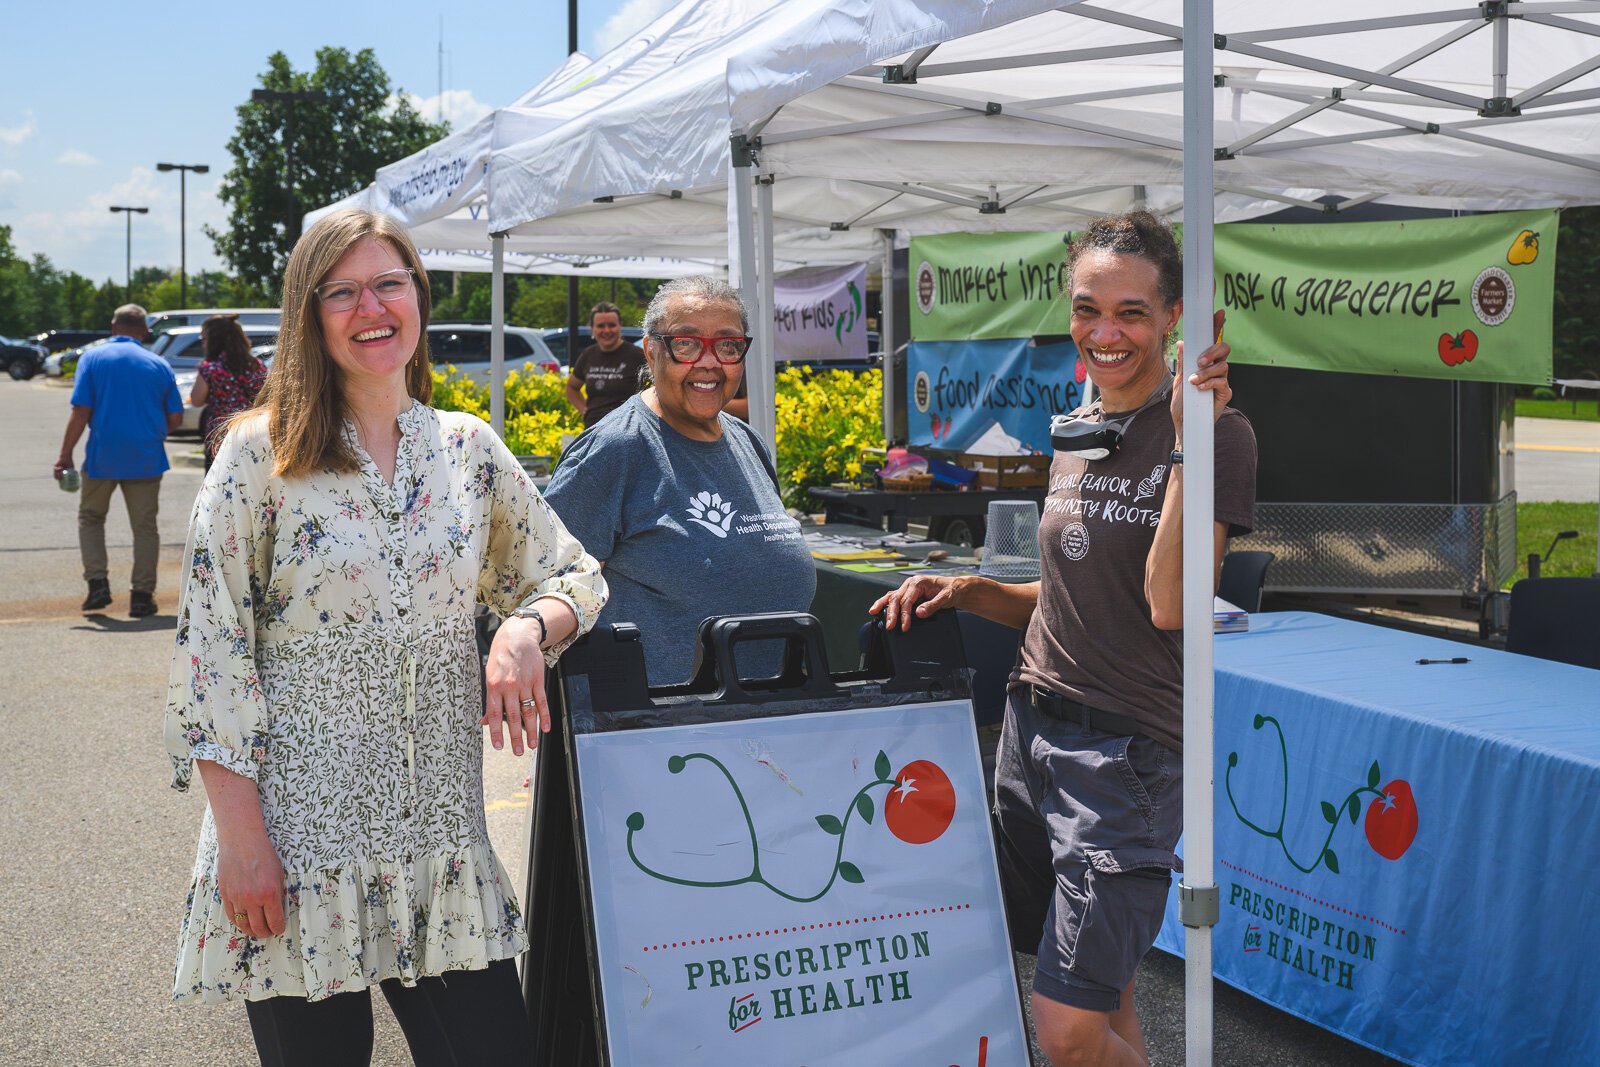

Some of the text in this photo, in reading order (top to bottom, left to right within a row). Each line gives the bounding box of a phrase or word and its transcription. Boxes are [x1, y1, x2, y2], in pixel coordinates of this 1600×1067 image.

[938, 262, 1008, 305] market
[1224, 272, 1461, 318] ask a gardener
[934, 365, 980, 411] food
[735, 522, 764, 535] Health
[1102, 499, 1161, 528] ROOTS
[1229, 883, 1377, 961] PRESCRIPTION
[684, 931, 931, 990] PRESCRIPTION
[1243, 923, 1356, 990] for HEALTH
[728, 971, 913, 1031] for HEALTH
